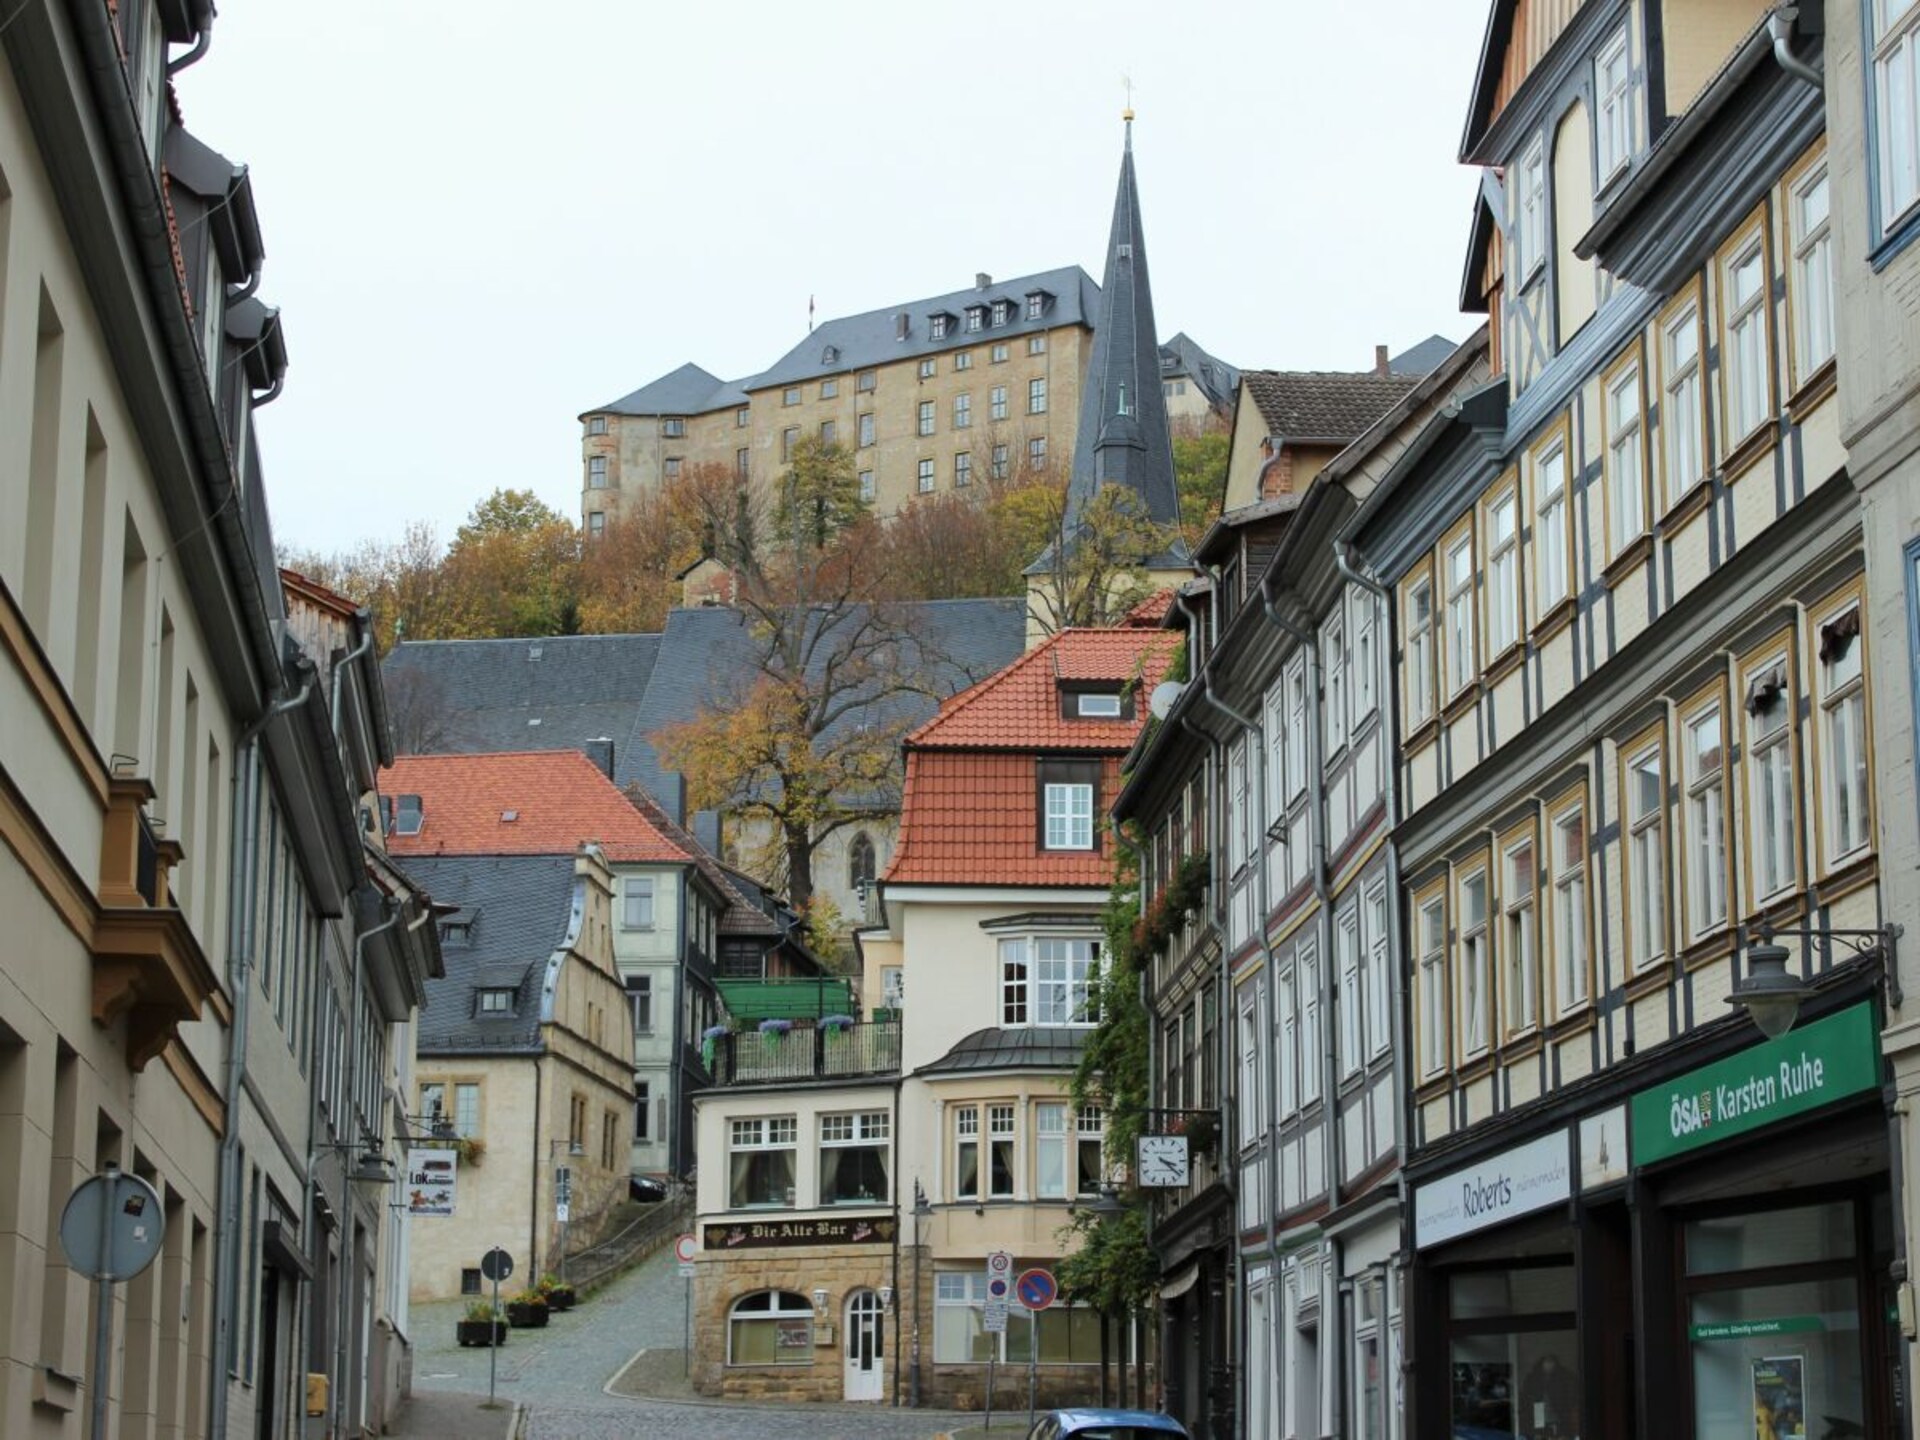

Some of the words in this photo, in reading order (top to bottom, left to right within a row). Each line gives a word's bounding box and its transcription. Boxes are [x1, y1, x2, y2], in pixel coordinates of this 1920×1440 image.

[1670, 1093, 1702, 1138] ÖSA
[1716, 1075, 1776, 1122] Karsten
[1780, 1051, 1824, 1099] Ruhe
[1463, 1173, 1512, 1218] Roberts
[752, 1224, 777, 1238] Die
[780, 1223, 813, 1237] Alte
[817, 1222, 847, 1236] Bar
